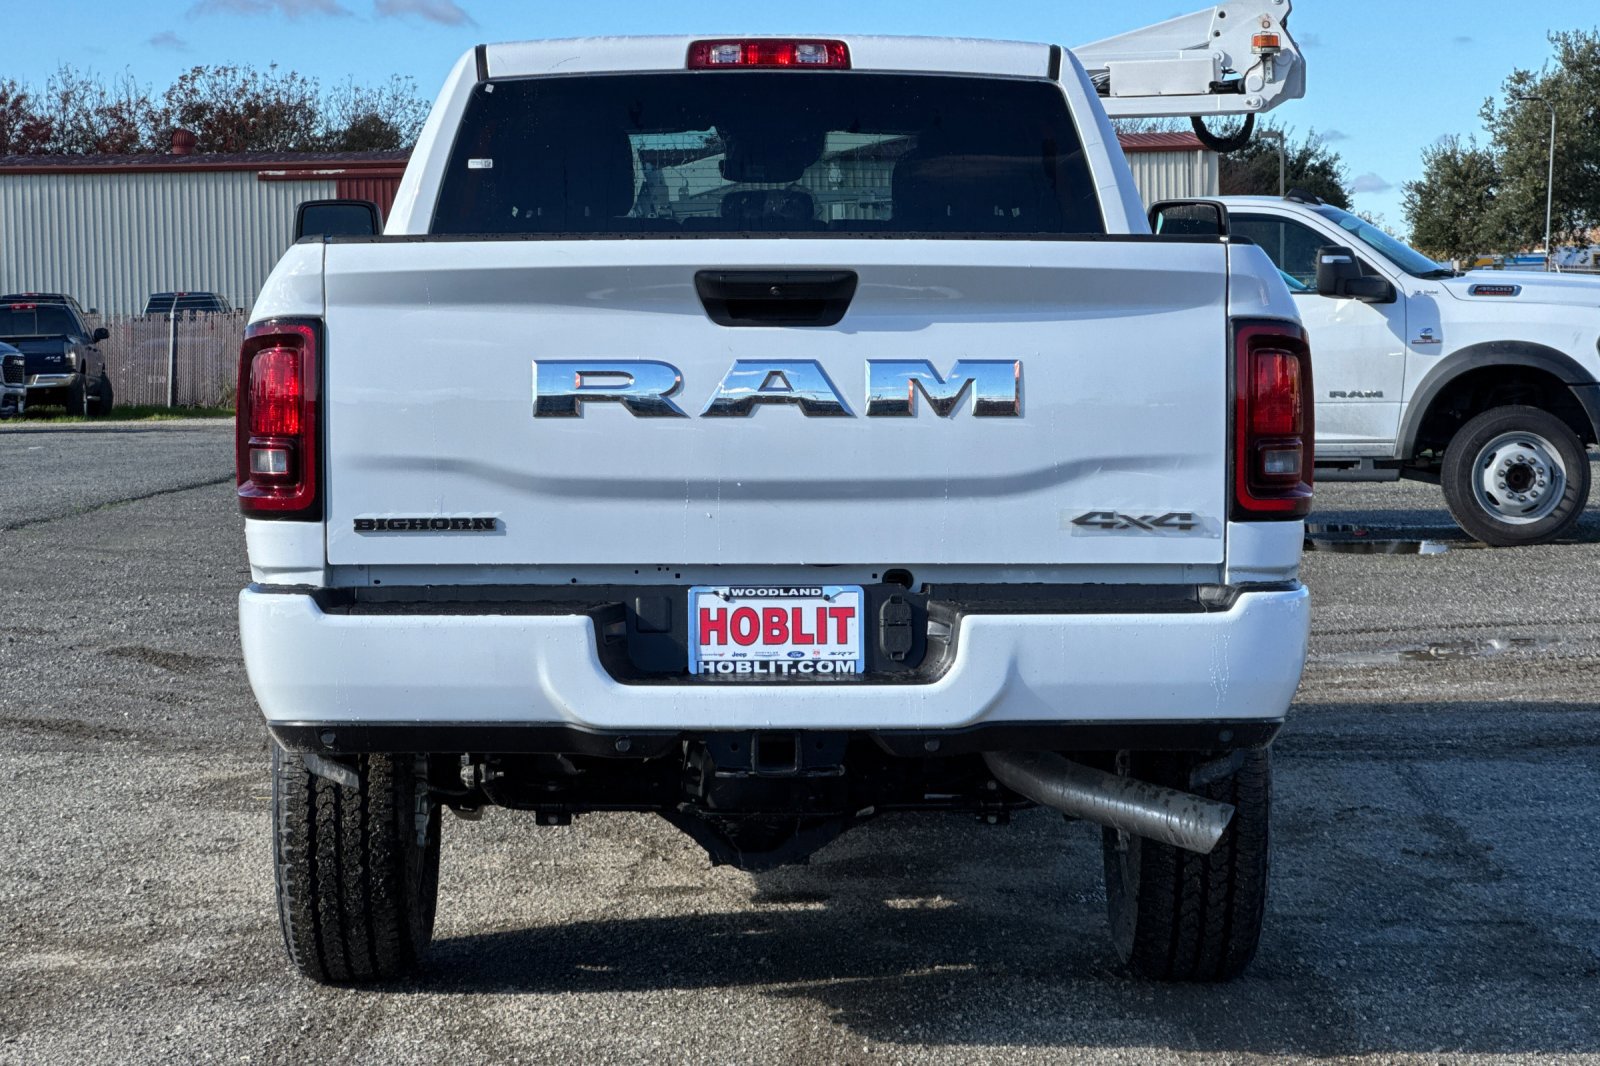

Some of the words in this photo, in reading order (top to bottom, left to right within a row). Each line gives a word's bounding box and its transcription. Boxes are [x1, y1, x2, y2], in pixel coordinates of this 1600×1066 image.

[533, 359, 1020, 418] RAM
[353, 517, 497, 531] BIGHORN
[731, 588, 822, 597] WOODLAND
[699, 606, 856, 646] HOBLIT
[698, 660, 856, 674] HOBLIT.COM
